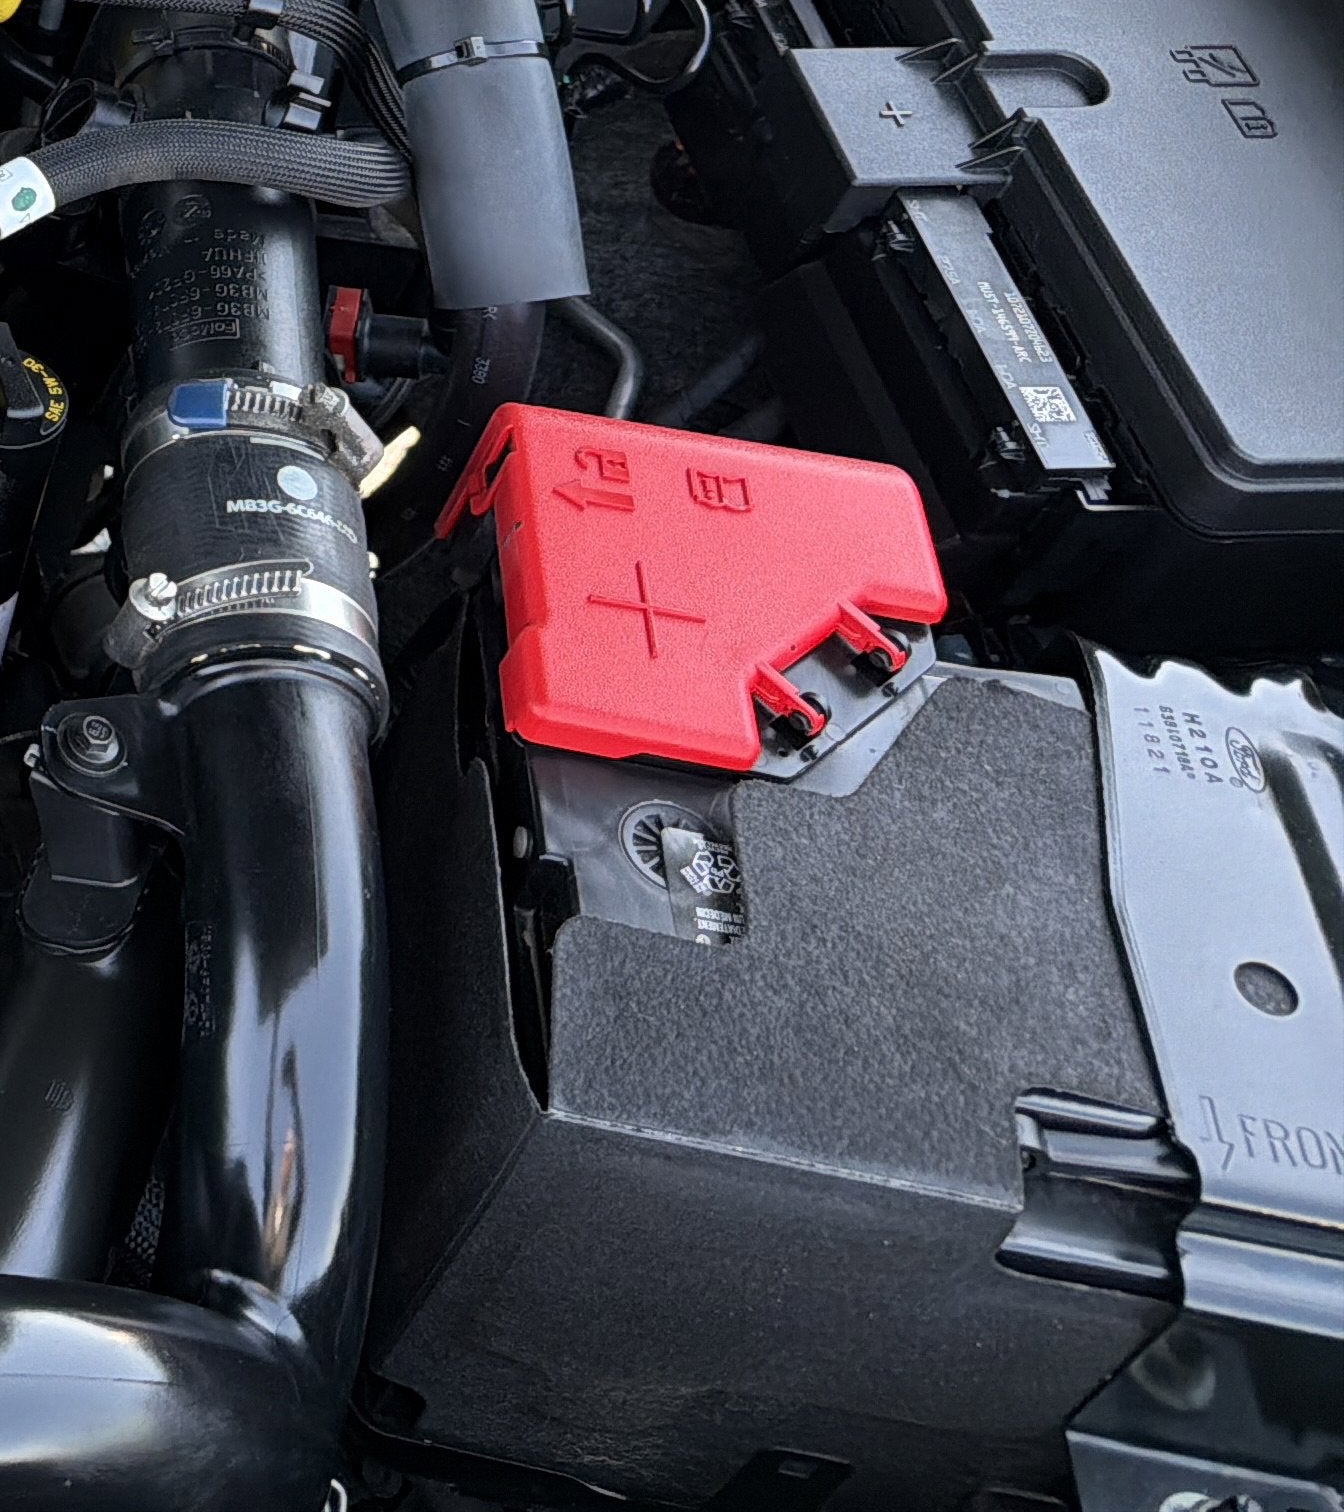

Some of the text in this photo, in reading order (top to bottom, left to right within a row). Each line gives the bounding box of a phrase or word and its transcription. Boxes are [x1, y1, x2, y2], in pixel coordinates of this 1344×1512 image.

[23, 356, 64, 421] SAE 5W-30
[1133, 707, 1171, 774] 11821
[1182, 712, 1224, 784] H210A
